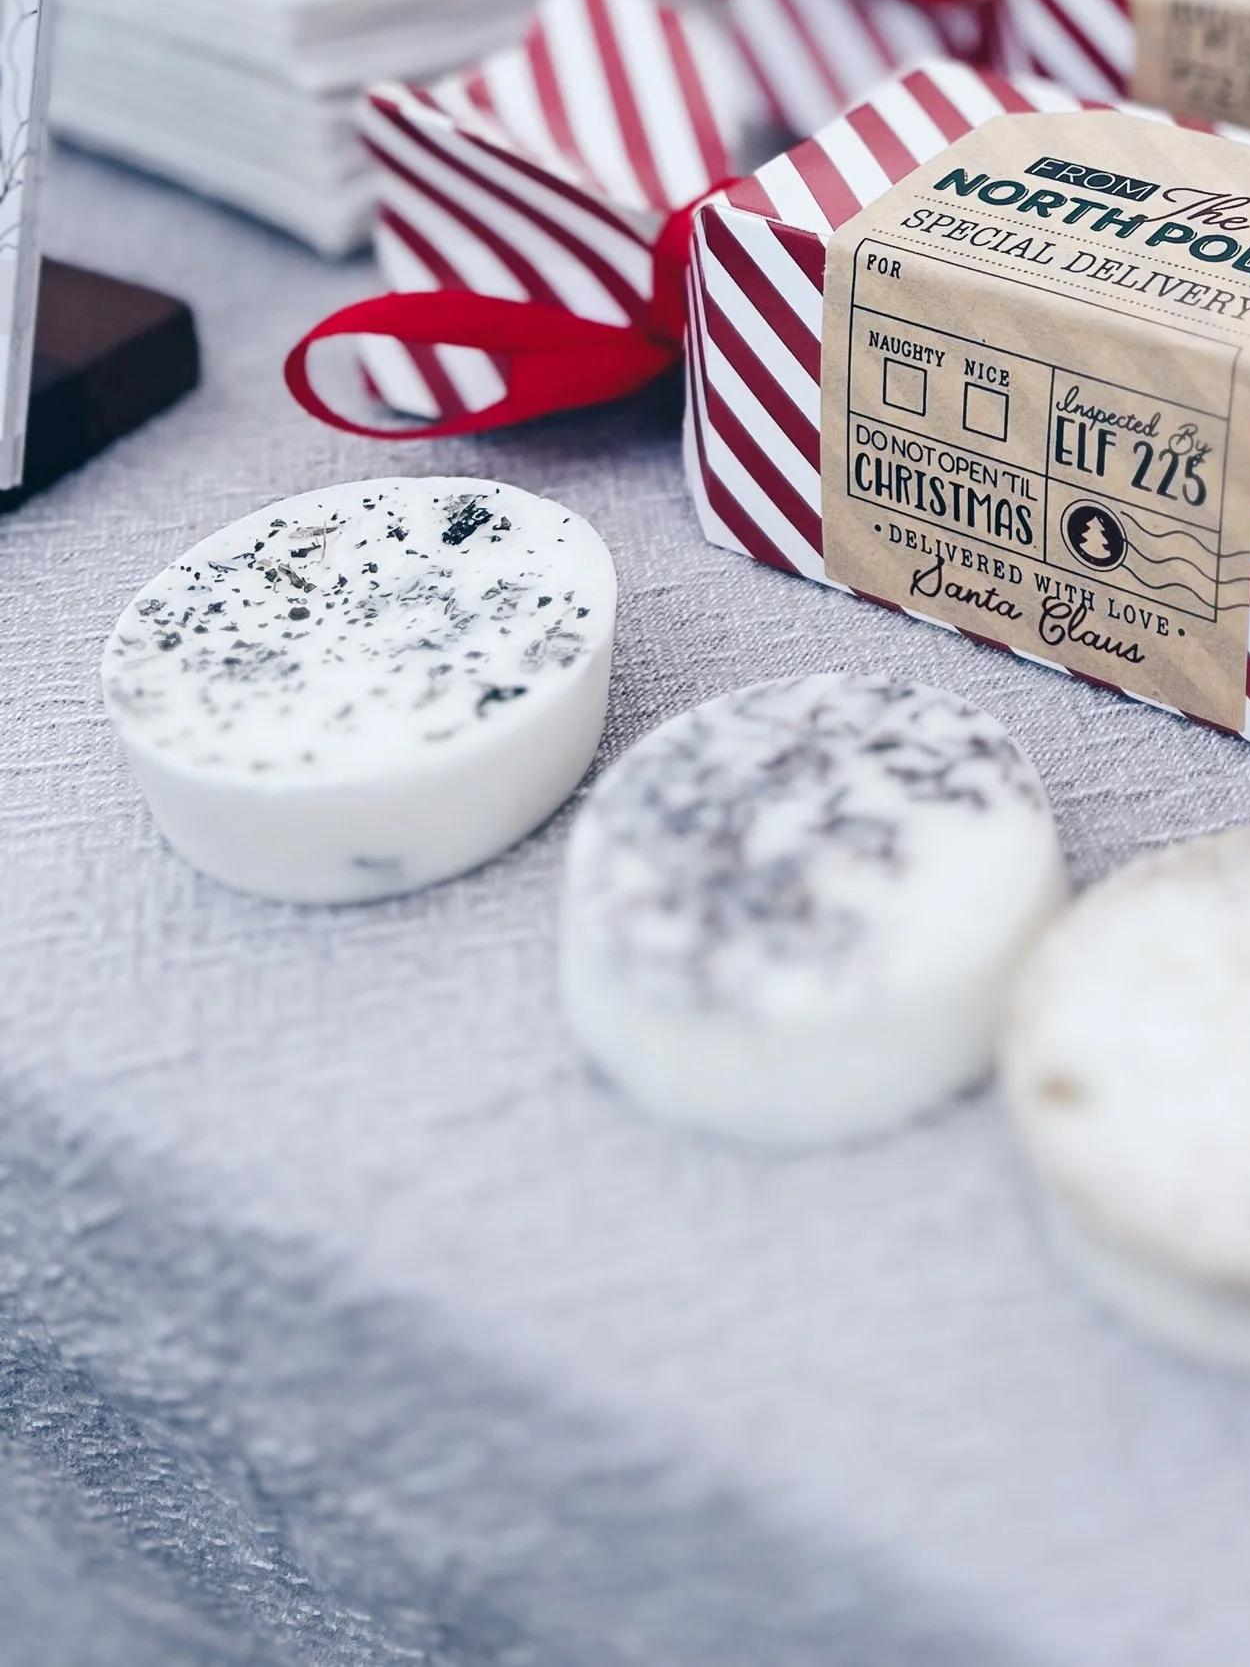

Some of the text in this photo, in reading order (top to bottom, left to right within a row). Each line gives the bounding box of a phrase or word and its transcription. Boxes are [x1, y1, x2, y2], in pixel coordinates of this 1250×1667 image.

[933, 167, 1146, 239] NORTH
[1030, 160, 1156, 201] FROM
[866, 253, 902, 280] FOR
[900, 208, 1057, 265] SPECIAL
[868, 330, 1010, 387] NAUGHTY NICE
[856, 423, 888, 451] DO
[890, 435, 936, 466] NOT
[937, 451, 998, 489] OPEN
[1055, 385, 1213, 464] Inspected By
[1054, 415, 1207, 507] ELF 225
[855, 452, 1033, 546] CHRISTMAS
[888, 522, 1170, 637] DELIVERED WITH LOVE
[910, 555, 1145, 664] Santa Claus
